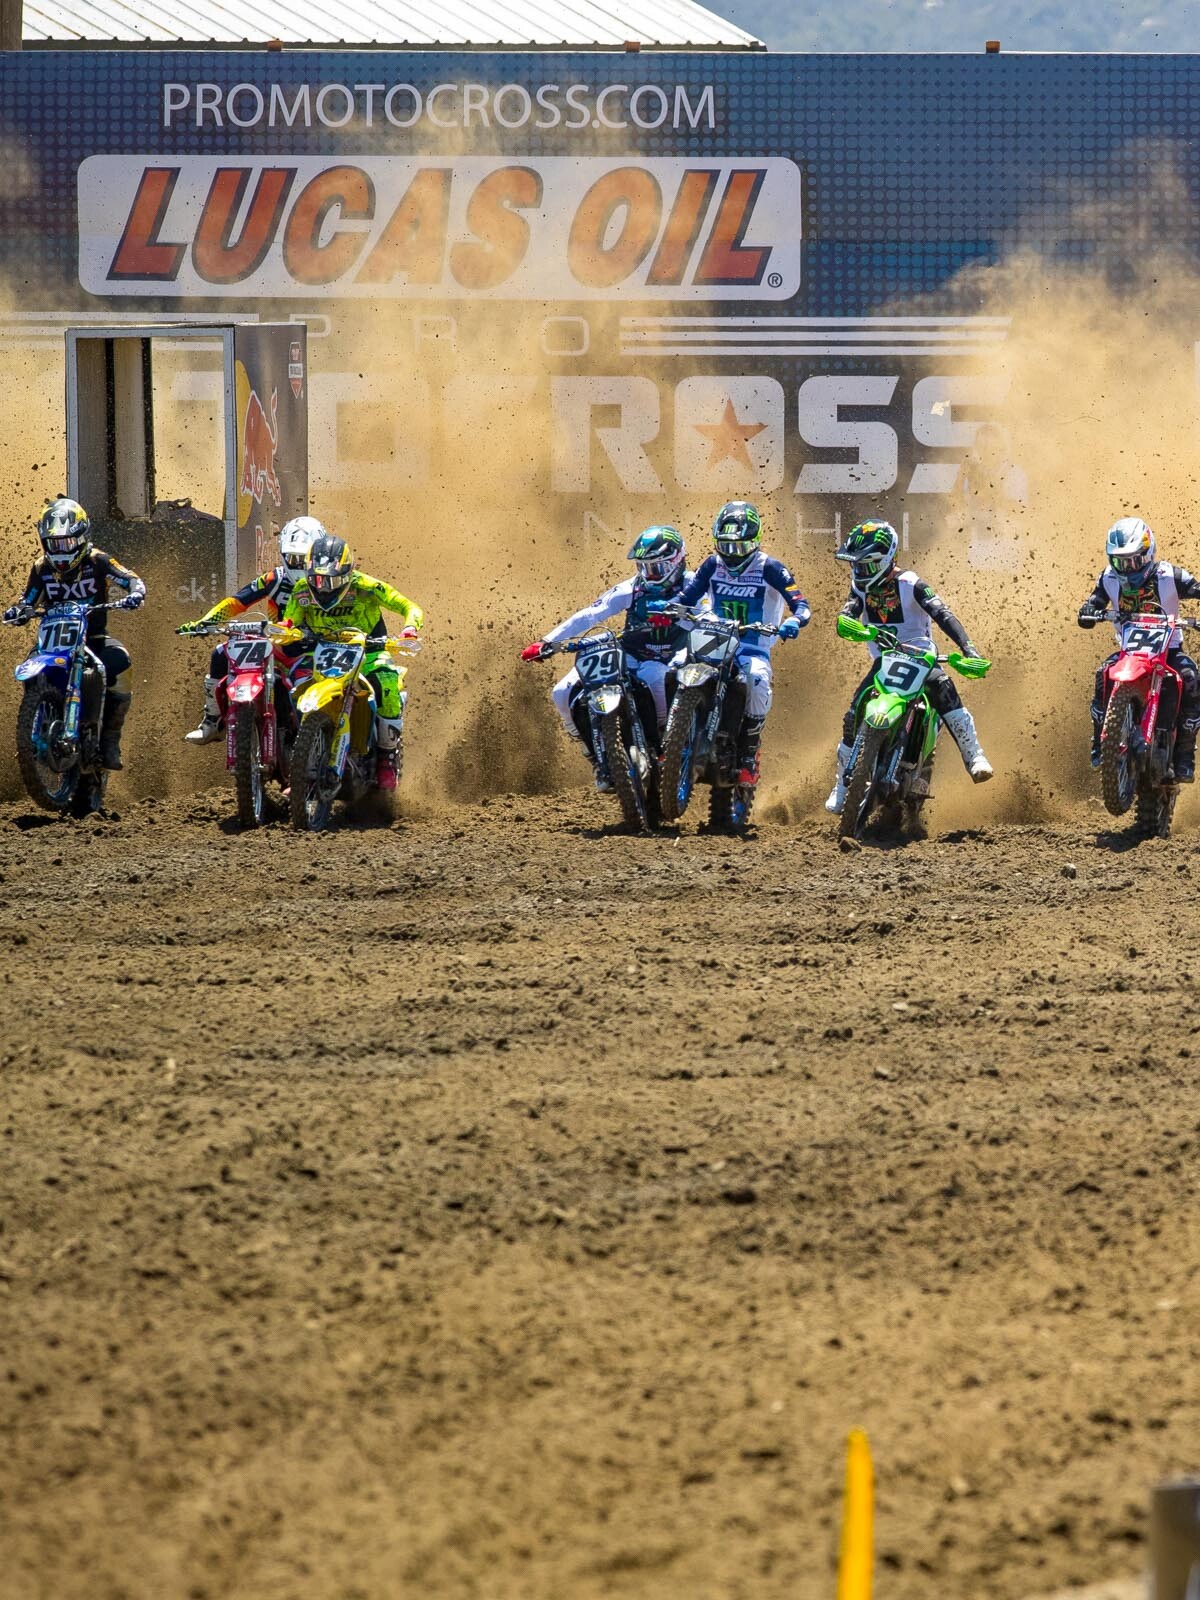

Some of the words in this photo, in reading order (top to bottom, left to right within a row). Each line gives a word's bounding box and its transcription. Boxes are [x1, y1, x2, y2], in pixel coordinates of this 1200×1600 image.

[163, 83, 716, 129] PROMOTOCROSS.COM
[106, 165, 544, 286] LUCAS
[567, 165, 774, 287] OIL
[45, 577, 98, 600] FXR
[716, 583, 758, 598] THOR
[42, 621, 80, 651] 715
[695, 630, 730, 657] 7
[1125, 629, 1166, 654] 94
[234, 641, 268, 668] 74
[316, 648, 358, 672] 34
[582, 650, 619, 680] 29
[884, 660, 920, 691] 9
